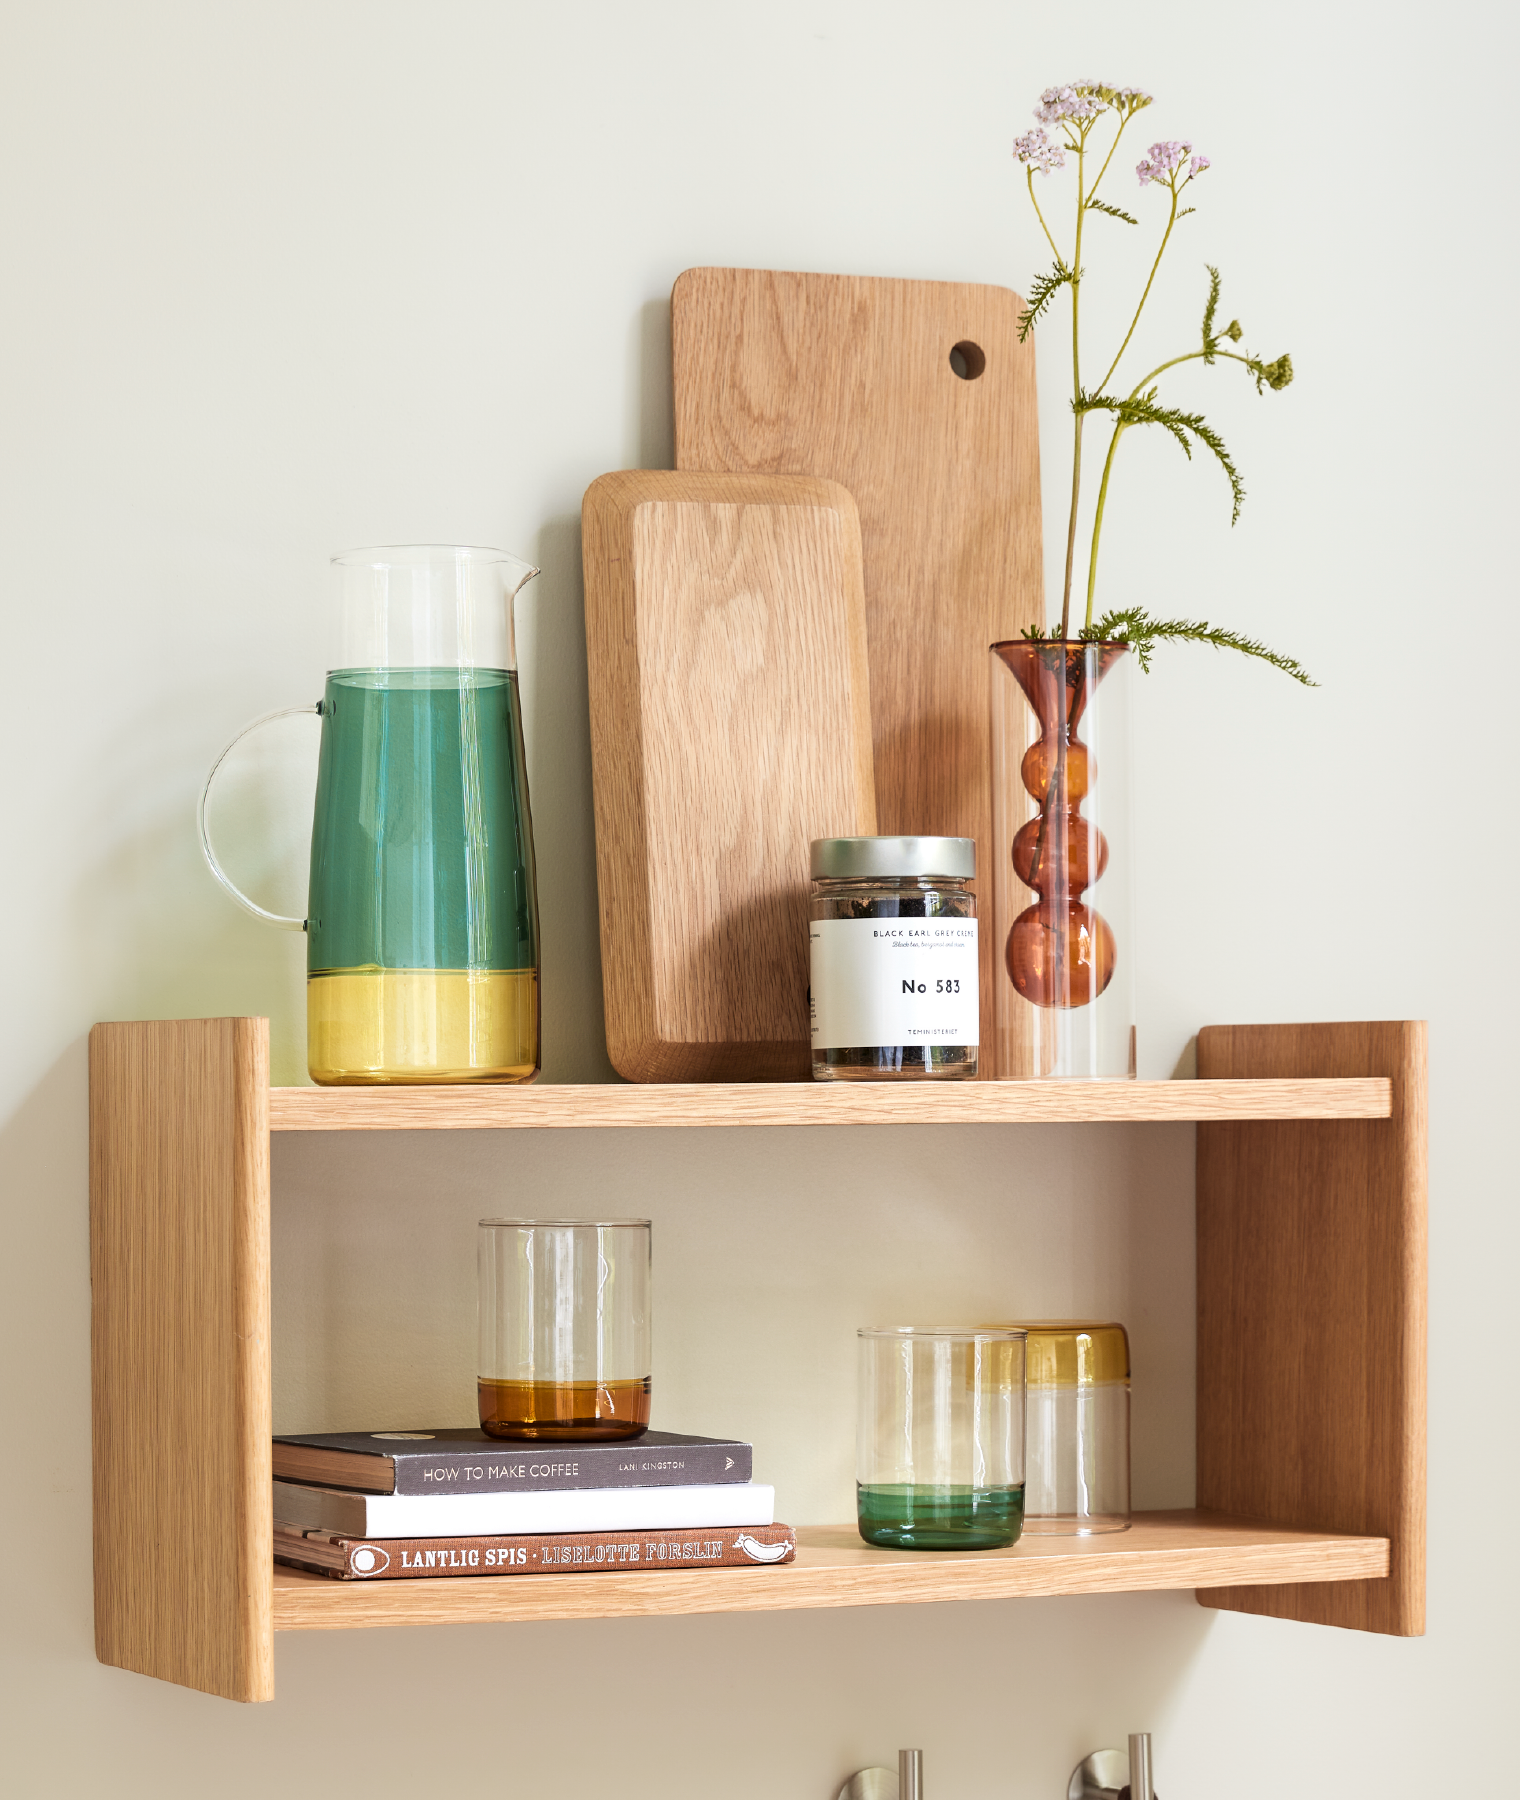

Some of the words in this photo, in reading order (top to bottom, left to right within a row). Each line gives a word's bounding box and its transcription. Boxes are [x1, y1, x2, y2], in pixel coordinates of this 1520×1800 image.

[873, 930, 904, 938] BLACK
[902, 980, 927, 994] No
[936, 980, 960, 994] 583
[423, 1467, 460, 1482] HOW
[464, 1466, 484, 1481] TO
[488, 1465, 526, 1479] MAKE
[529, 1463, 579, 1477] COFFEE
[642, 1461, 685, 1471] KINGSTON
[401, 1550, 480, 1568] LANTLIG
[485, 1547, 527, 1566] SPIS
[541, 1543, 640, 1564] LISELOTTE
[646, 1541, 723, 1561] FORSLIN
